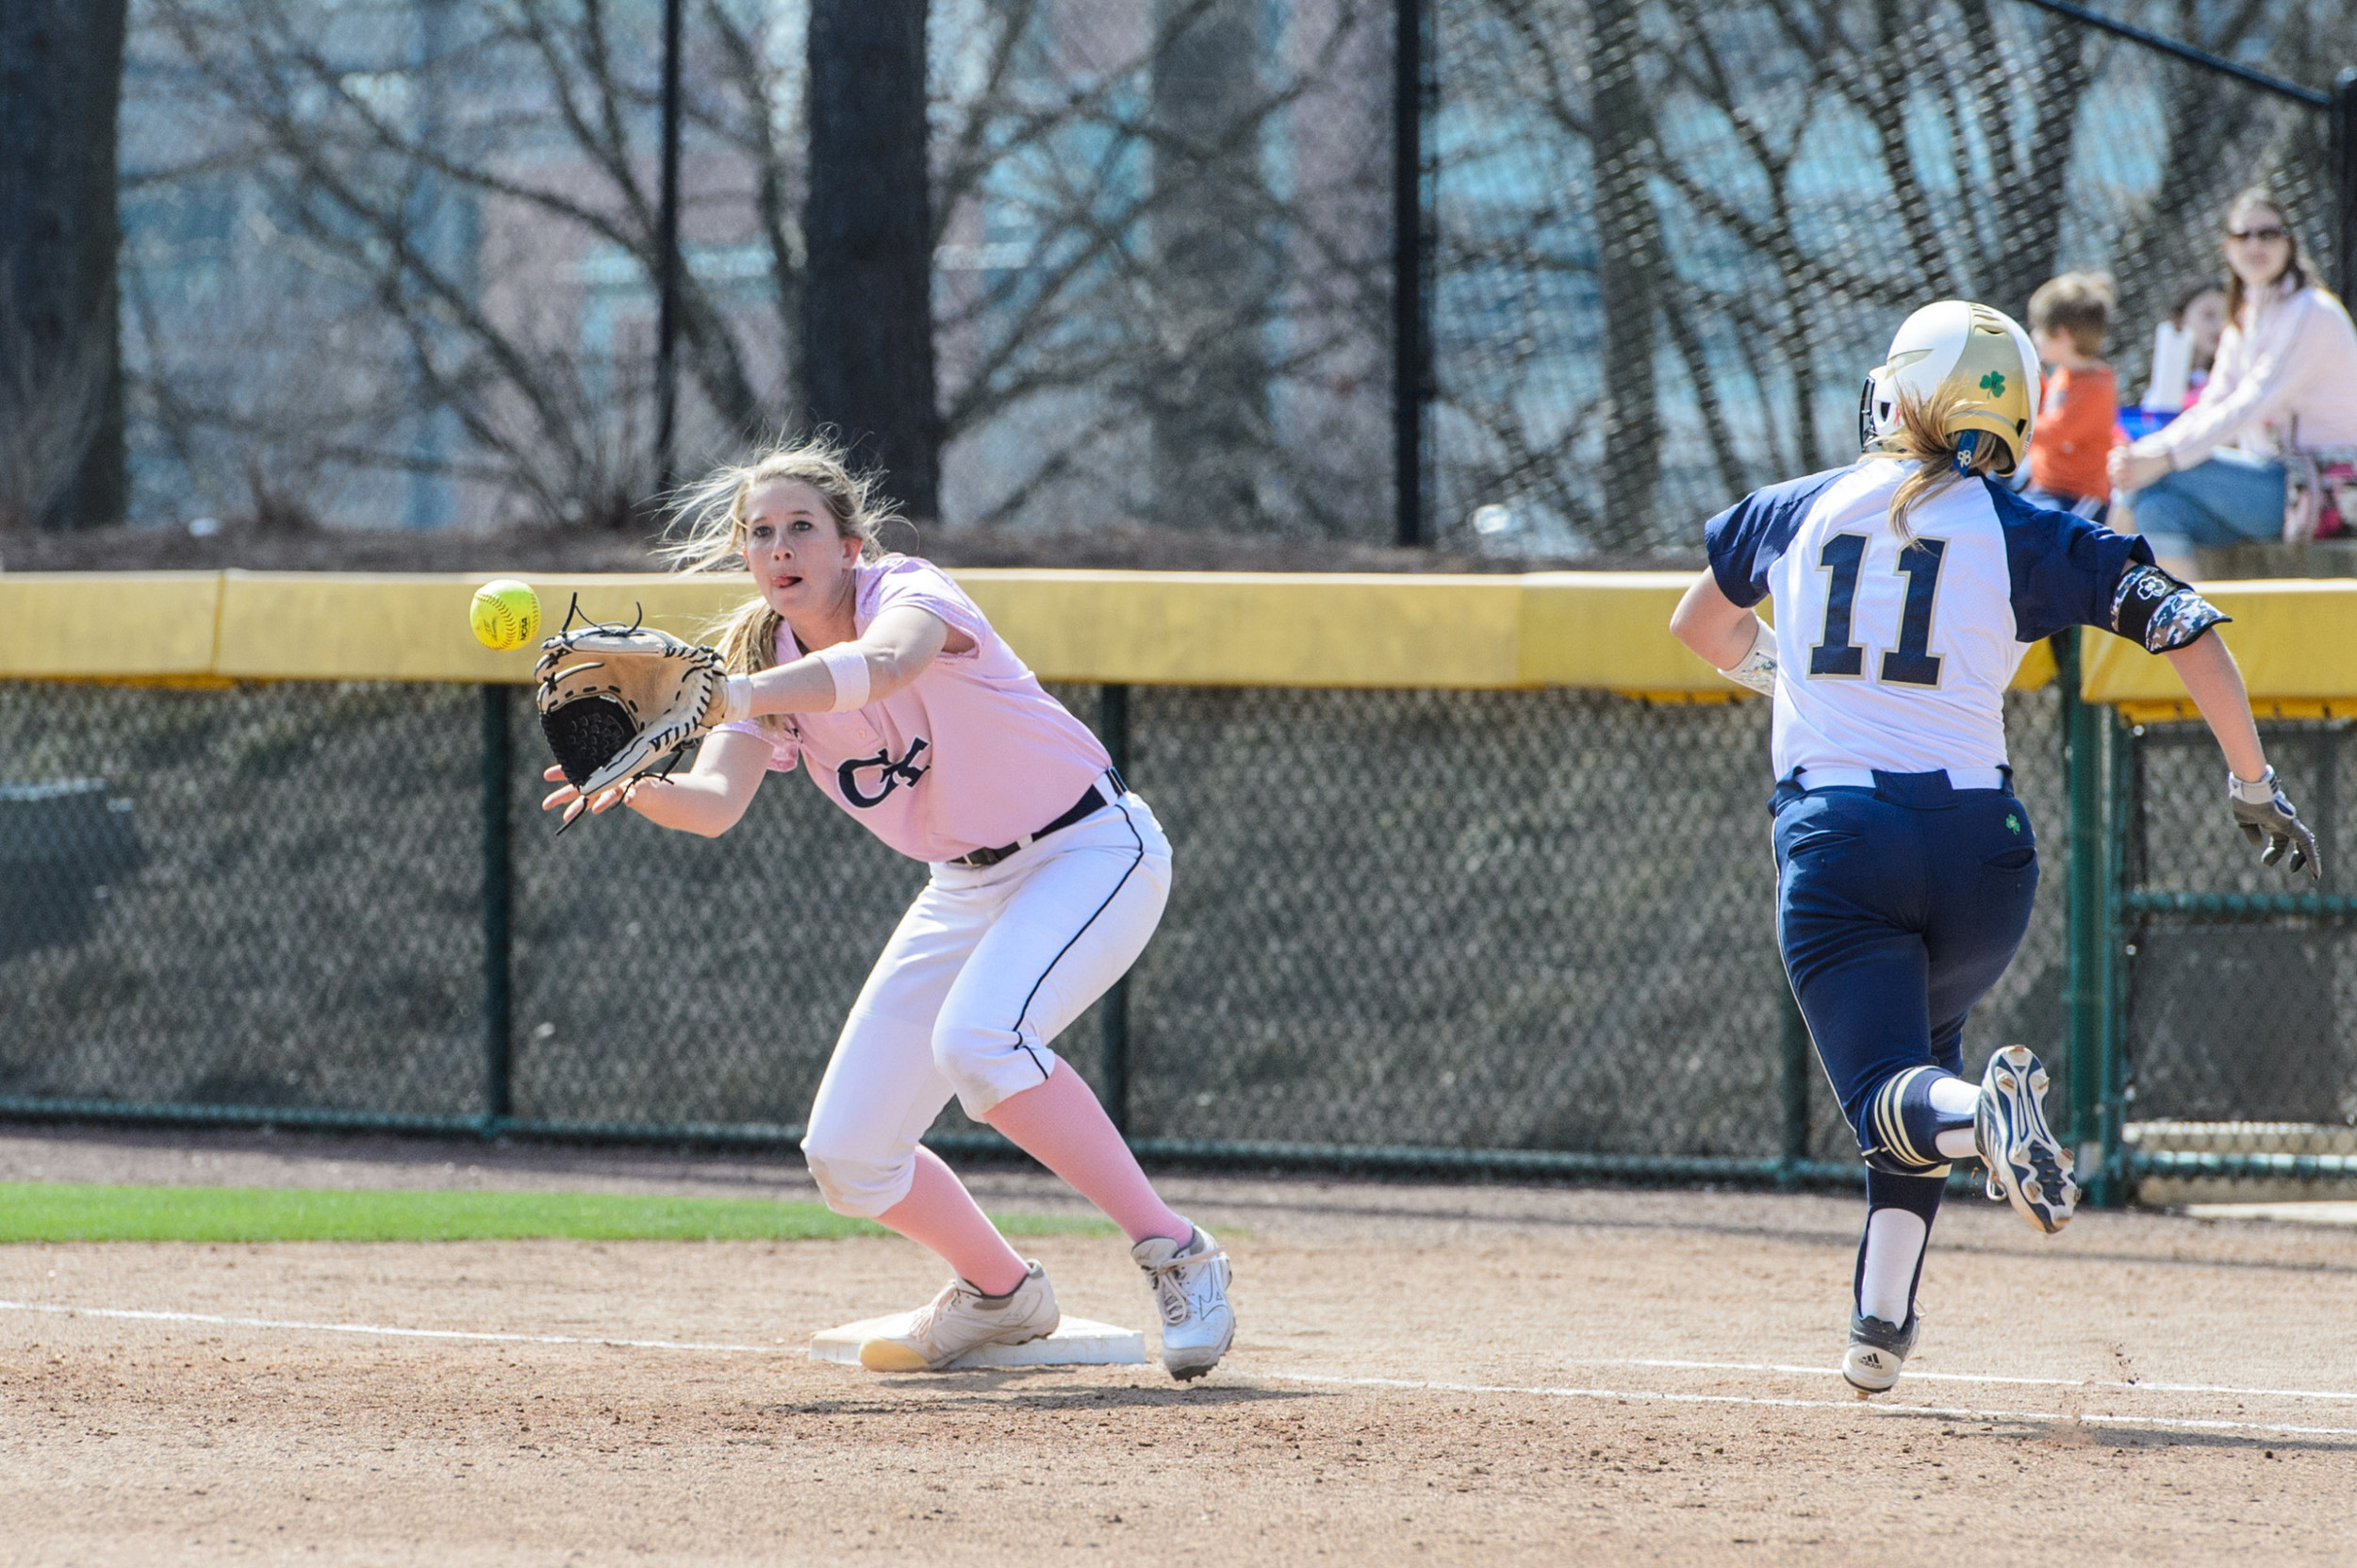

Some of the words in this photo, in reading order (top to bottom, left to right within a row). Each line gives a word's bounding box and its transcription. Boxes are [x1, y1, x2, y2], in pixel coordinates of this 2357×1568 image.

[1805, 530, 1951, 690] 11
[519, 617, 528, 641] NCAA
[1858, 1359, 1883, 1370] adidas
